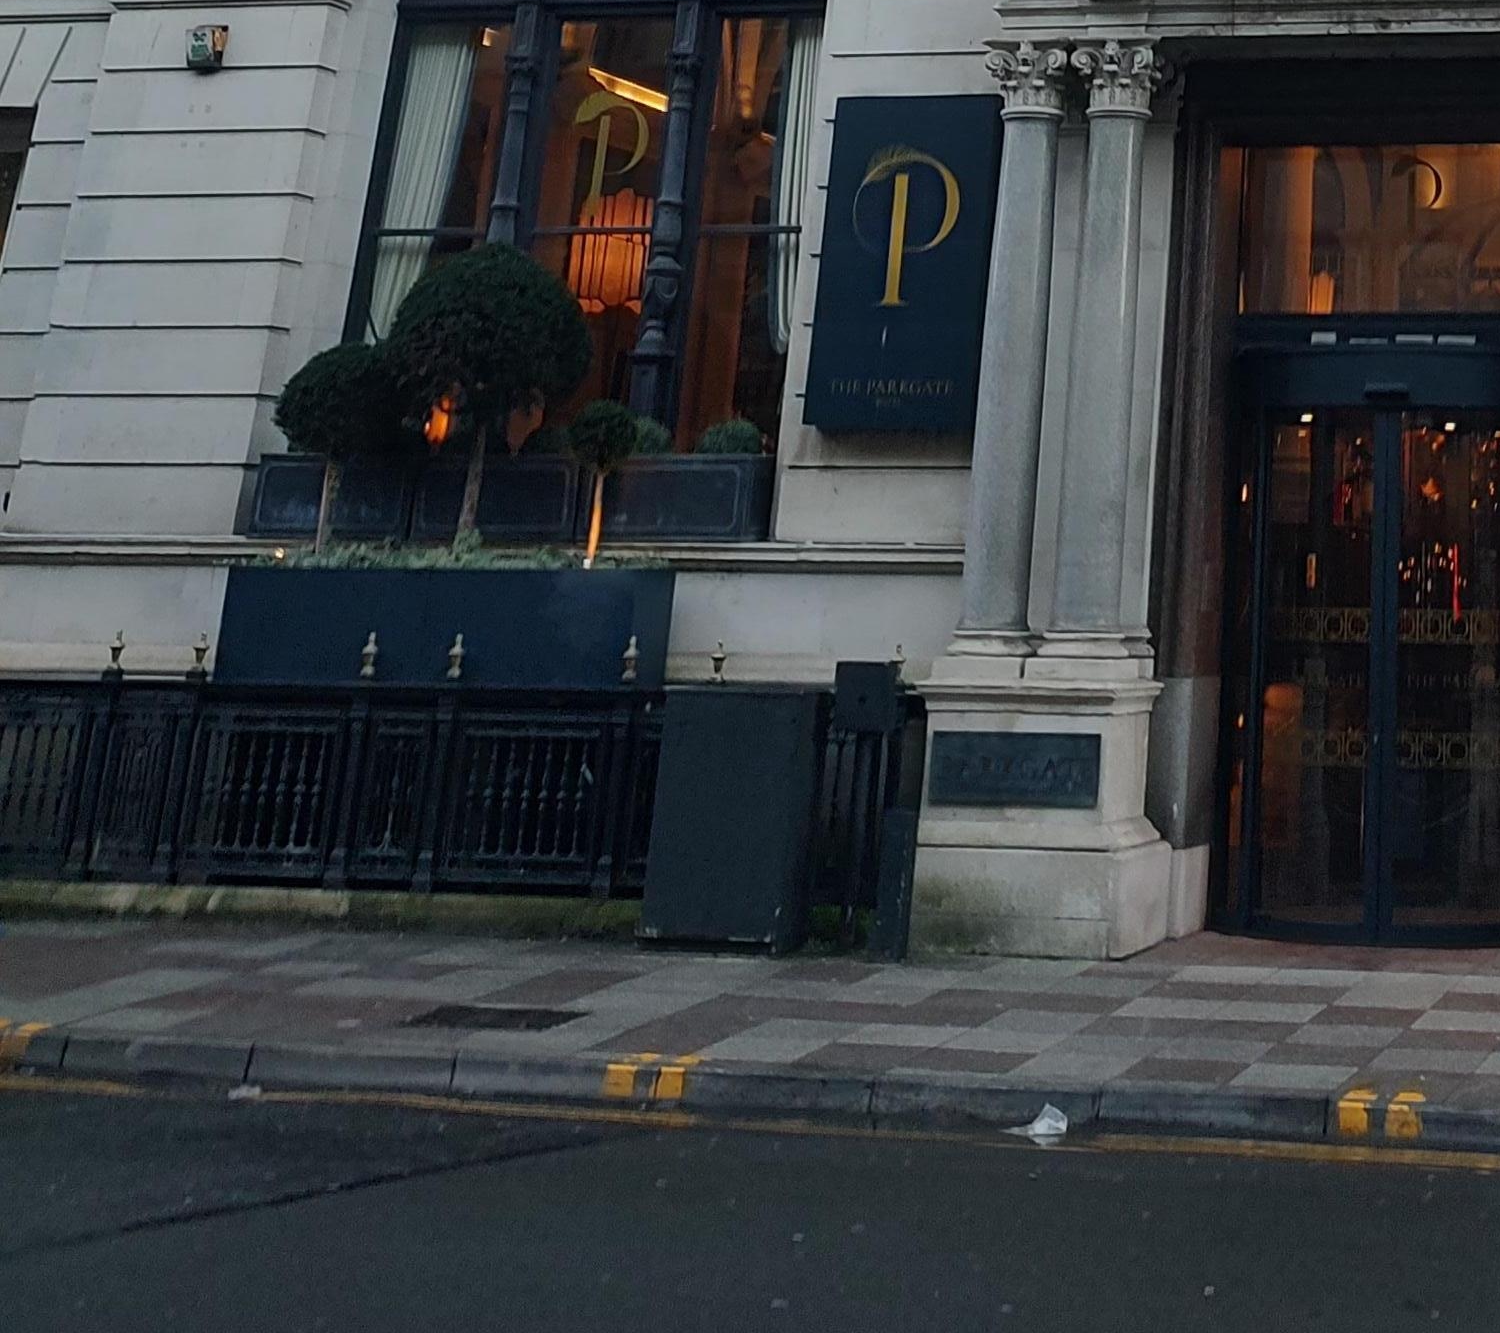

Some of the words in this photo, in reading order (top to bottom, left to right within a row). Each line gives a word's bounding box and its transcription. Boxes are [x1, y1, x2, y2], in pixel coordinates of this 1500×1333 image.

[573, 89, 650, 218] P
[852, 143, 961, 309] P
[830, 378, 862, 396] THE
[866, 378, 953, 396] PARKGATE
